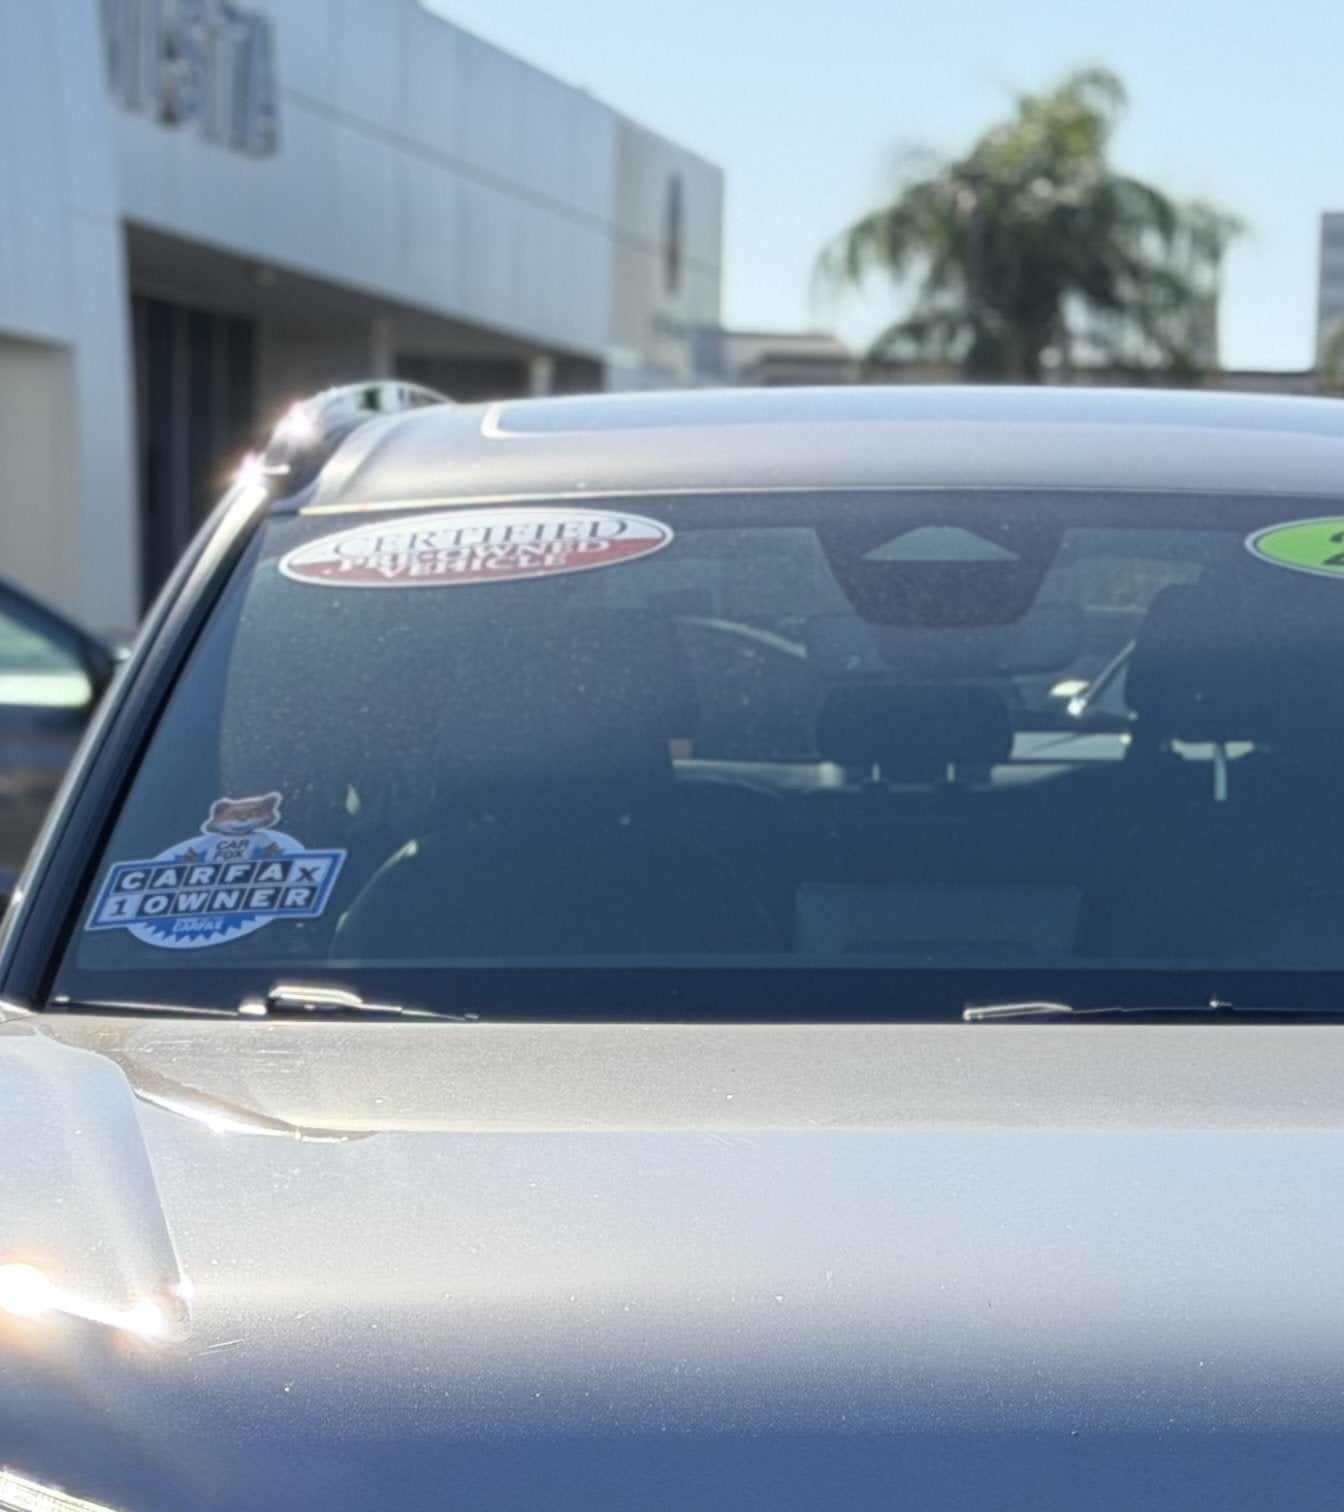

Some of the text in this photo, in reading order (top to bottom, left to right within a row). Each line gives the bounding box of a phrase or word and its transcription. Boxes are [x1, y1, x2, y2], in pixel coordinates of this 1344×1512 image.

[334, 519, 628, 556] CERTIFIED
[376, 553, 567, 578] VEHICLE
[121, 863, 320, 891] CARFAX
[109, 889, 309, 917] 1 OWNER
